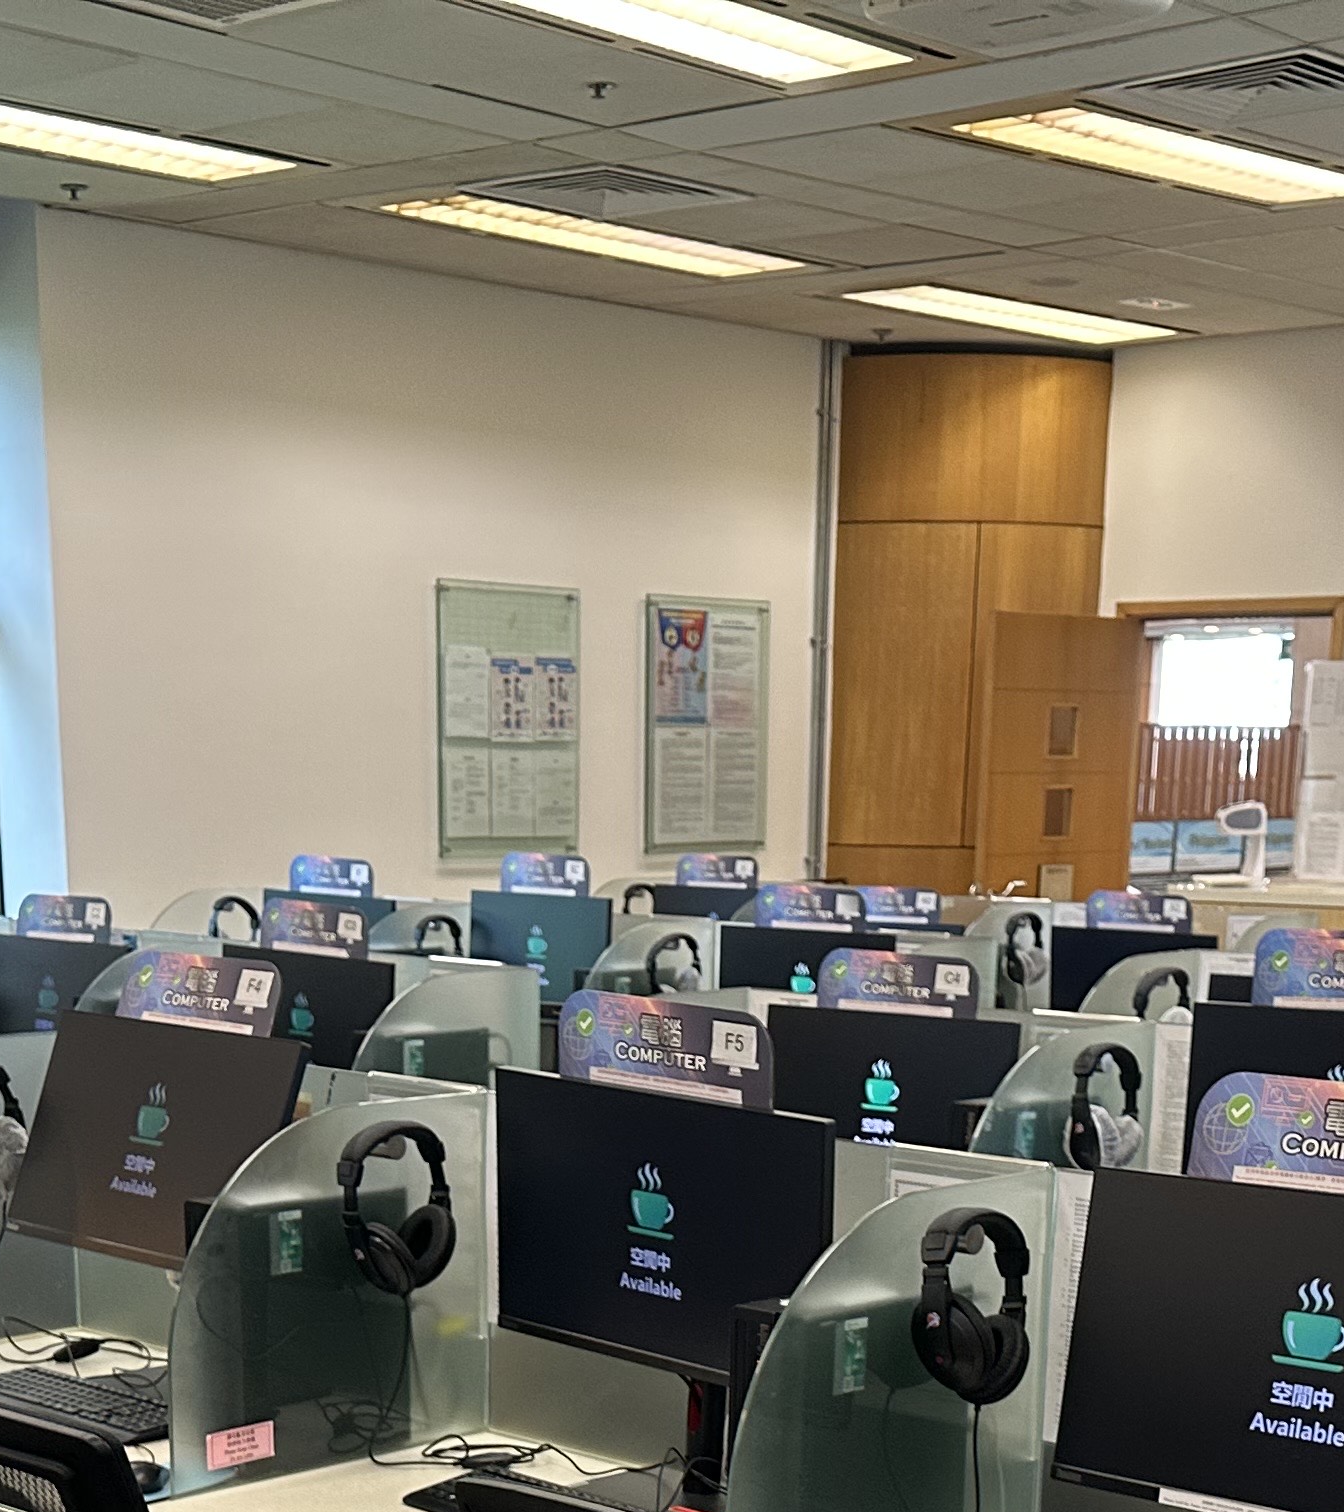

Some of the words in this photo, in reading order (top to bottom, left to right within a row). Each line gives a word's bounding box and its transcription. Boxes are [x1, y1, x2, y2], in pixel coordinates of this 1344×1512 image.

[246, 977, 263, 994] F4
[861, 981, 929, 999] COMPUTER
[162, 989, 230, 1012] COMPUTER
[724, 1032, 745, 1053] F5
[614, 1041, 707, 1073] COMPUTER
[619, 1271, 683, 1302] Available
